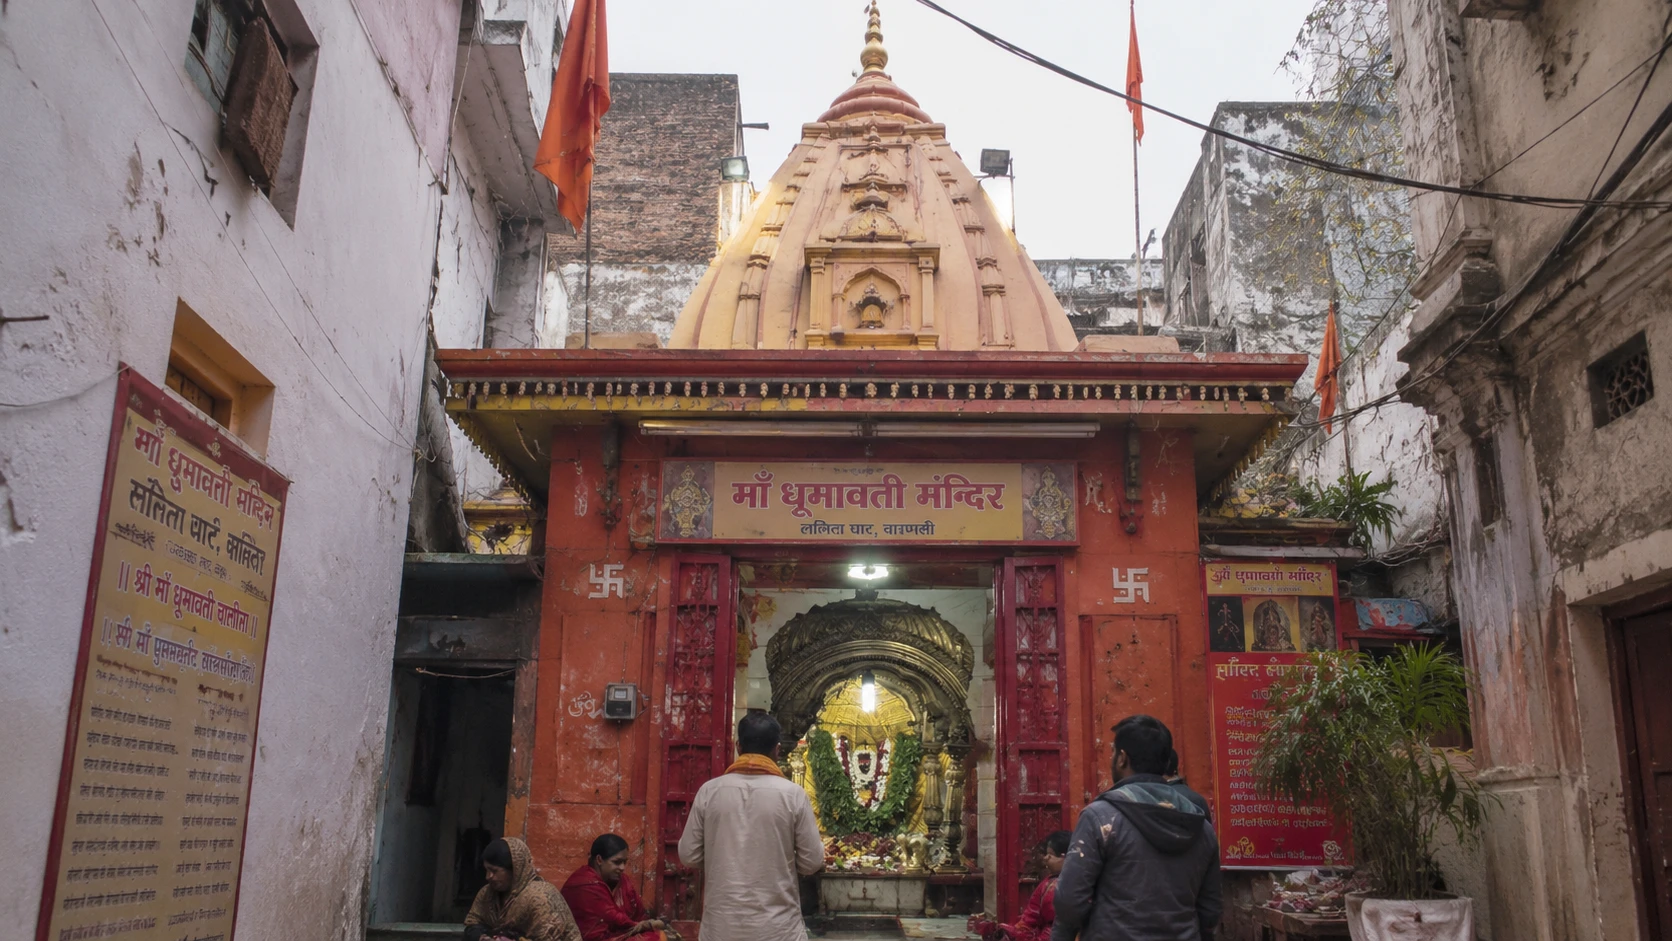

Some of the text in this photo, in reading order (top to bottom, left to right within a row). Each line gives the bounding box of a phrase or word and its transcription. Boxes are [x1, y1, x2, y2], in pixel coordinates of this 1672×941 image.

[731, 470, 774, 509] माँ
[780, 473, 908, 518] धूमावती
[800, 520, 845, 535] ललिता
